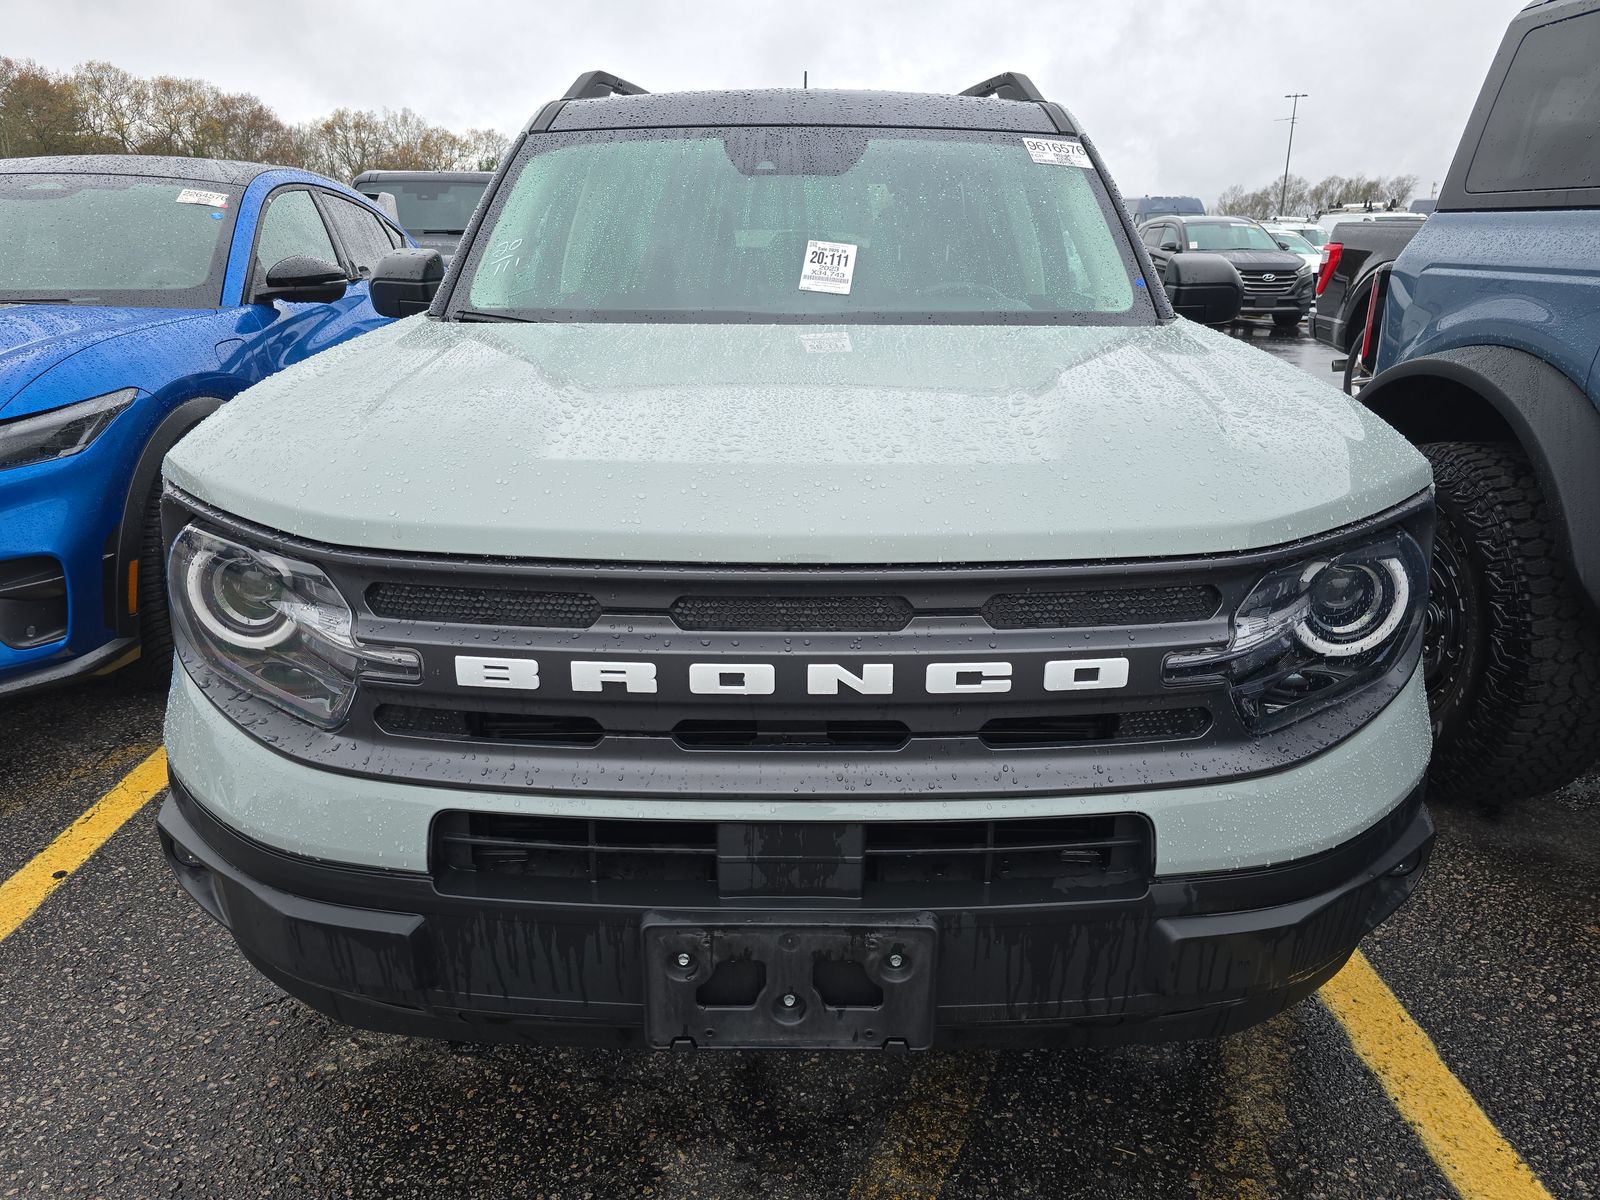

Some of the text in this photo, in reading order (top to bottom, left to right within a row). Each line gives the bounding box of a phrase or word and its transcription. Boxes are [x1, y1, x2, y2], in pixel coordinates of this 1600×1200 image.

[1026, 140, 1086, 156] 9616576
[809, 250, 849, 267] 20:111
[818, 264, 840, 272] 2023
[454, 655, 1130, 696] BRONCO
